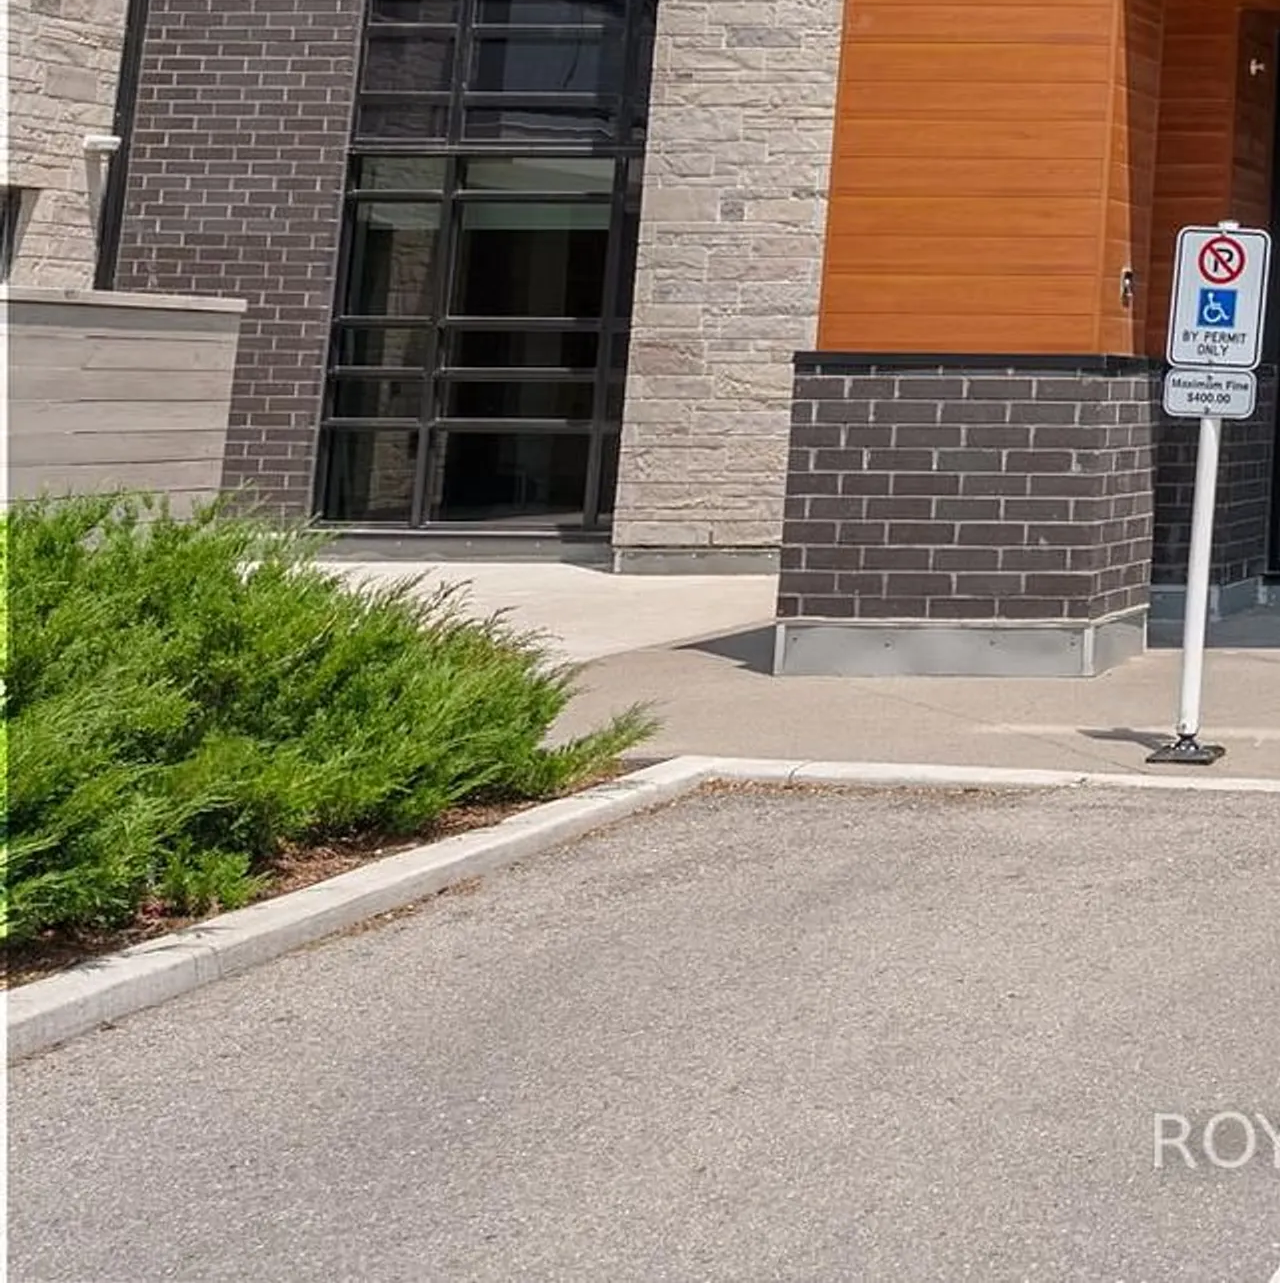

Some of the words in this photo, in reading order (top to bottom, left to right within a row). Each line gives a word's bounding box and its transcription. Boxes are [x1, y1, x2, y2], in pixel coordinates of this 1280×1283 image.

[1182, 329, 1199, 342] BY
[1204, 331, 1248, 345] PERMIT
[1196, 344, 1229, 357] ONLY
[1172, 377, 1223, 391] Maximum
[1226, 379, 1249, 392] Fine
[1186, 392, 1232, 405] $400.00
